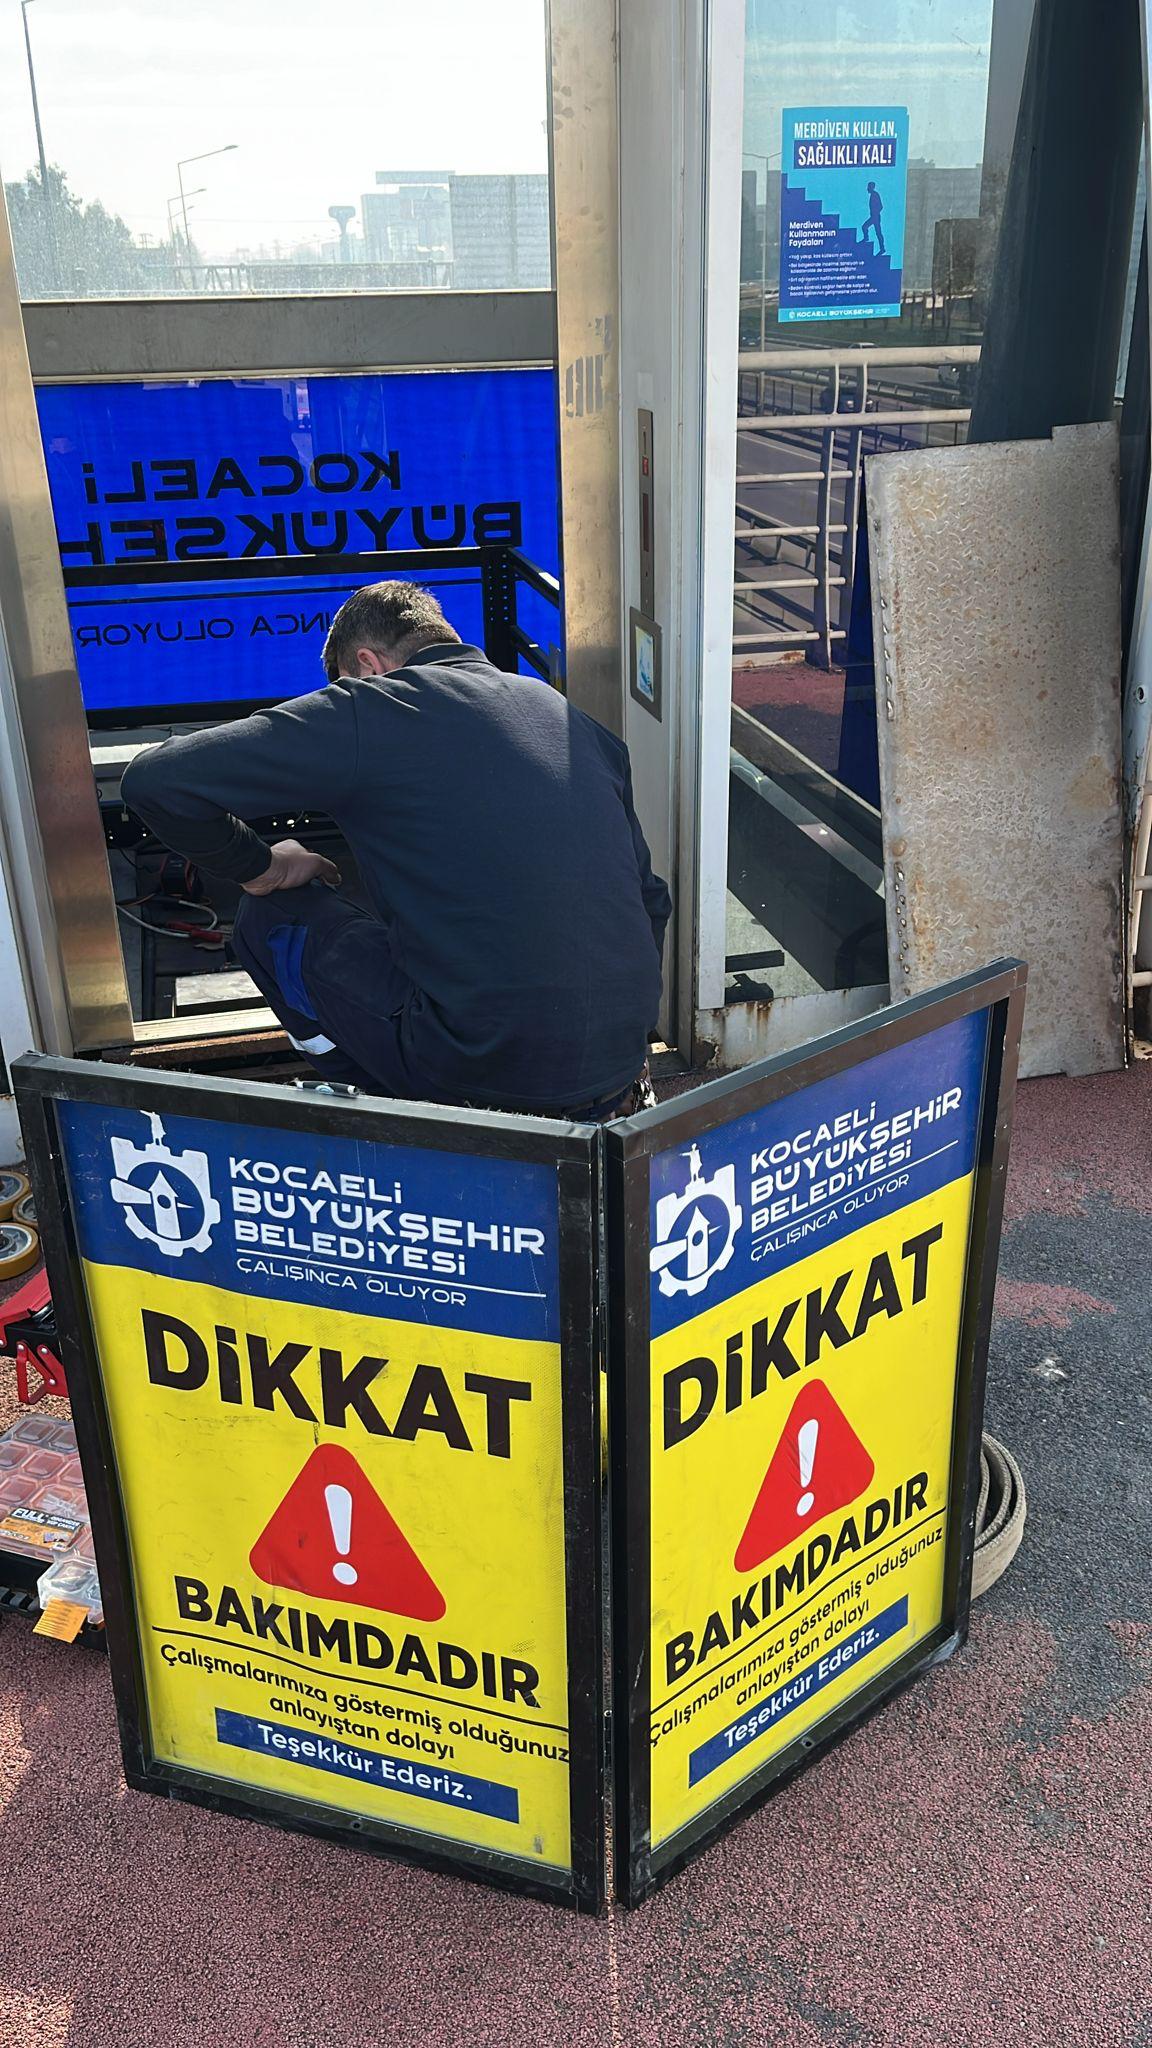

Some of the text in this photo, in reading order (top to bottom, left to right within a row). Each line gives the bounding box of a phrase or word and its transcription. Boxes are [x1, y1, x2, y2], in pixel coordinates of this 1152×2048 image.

[794, 120, 898, 138] MERDİVEN KULLAN,
[798, 142, 892, 166] SAĞLIKLI KAL!
[788, 238, 824, 248] Faydaları
[789, 220, 824, 229] Merdiven
[789, 230, 836, 238] Kullanmanın
[750, 1174, 910, 1262] ÇALIŞINCA OLUYOR
[236, 1257, 467, 1306] ÇALIŞINCA OLUYOR
[665, 1472, 928, 1687] BAKIMDADIR
[174, 1575, 542, 1708] BAKIMDADIR
[650, 1526, 942, 1748] Çalışmalarımıza göstermiş olduğunuz
[736, 1600, 870, 1706] anlayıştan dolayı
[160, 1644, 569, 1763] Çalışmalarımıza göstermiş olduğunuz
[724, 1626, 880, 1748] Teşekkür Ederiz.
[258, 1724, 473, 1800] Teşekkür Ederiz.
[270, 1696, 454, 1760] anlayıştan dolayı
